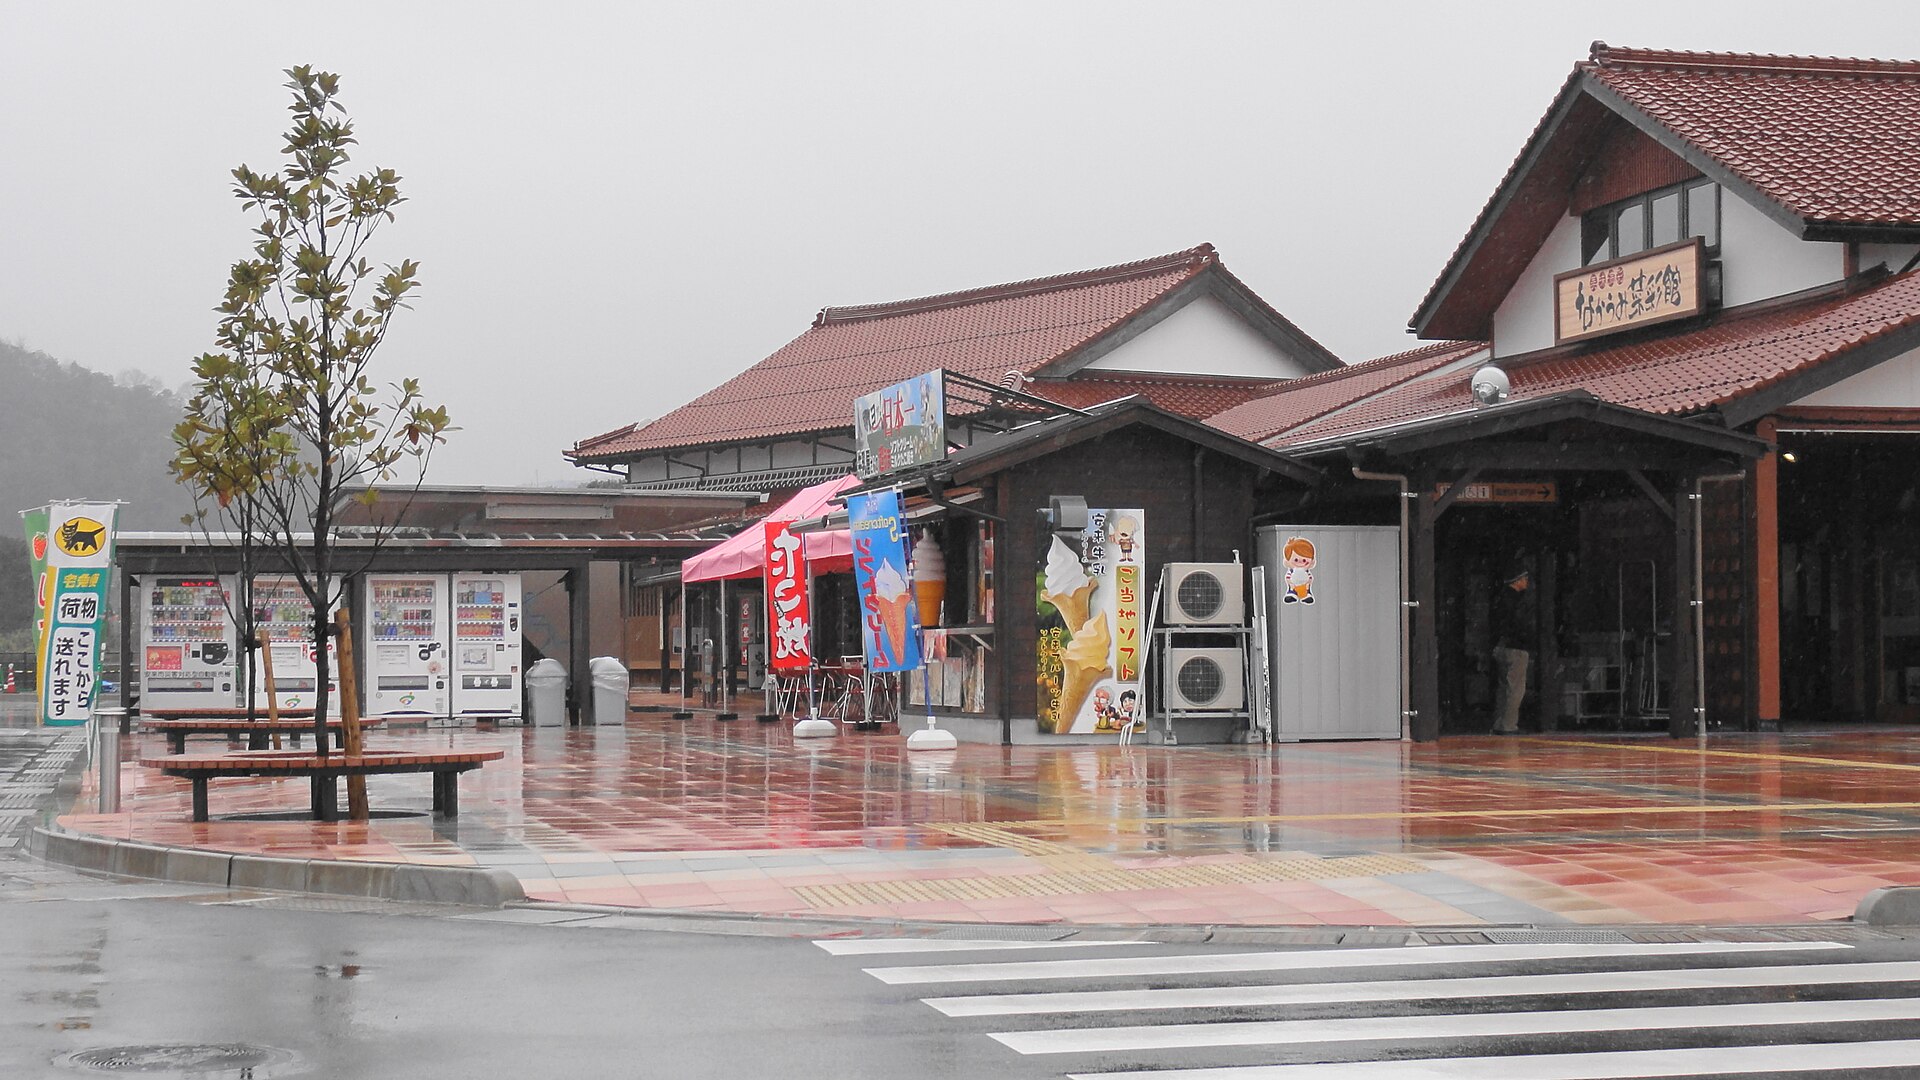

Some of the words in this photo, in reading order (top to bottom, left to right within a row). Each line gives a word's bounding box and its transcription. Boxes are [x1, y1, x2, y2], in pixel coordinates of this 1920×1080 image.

[1091, 512, 1106, 576] 安来牛乳
[60, 597, 97, 619] 荷物
[62, 573, 100, 589] 宅急便
[52, 636, 74, 717] 送れます
[75, 631, 91, 709] ここから
